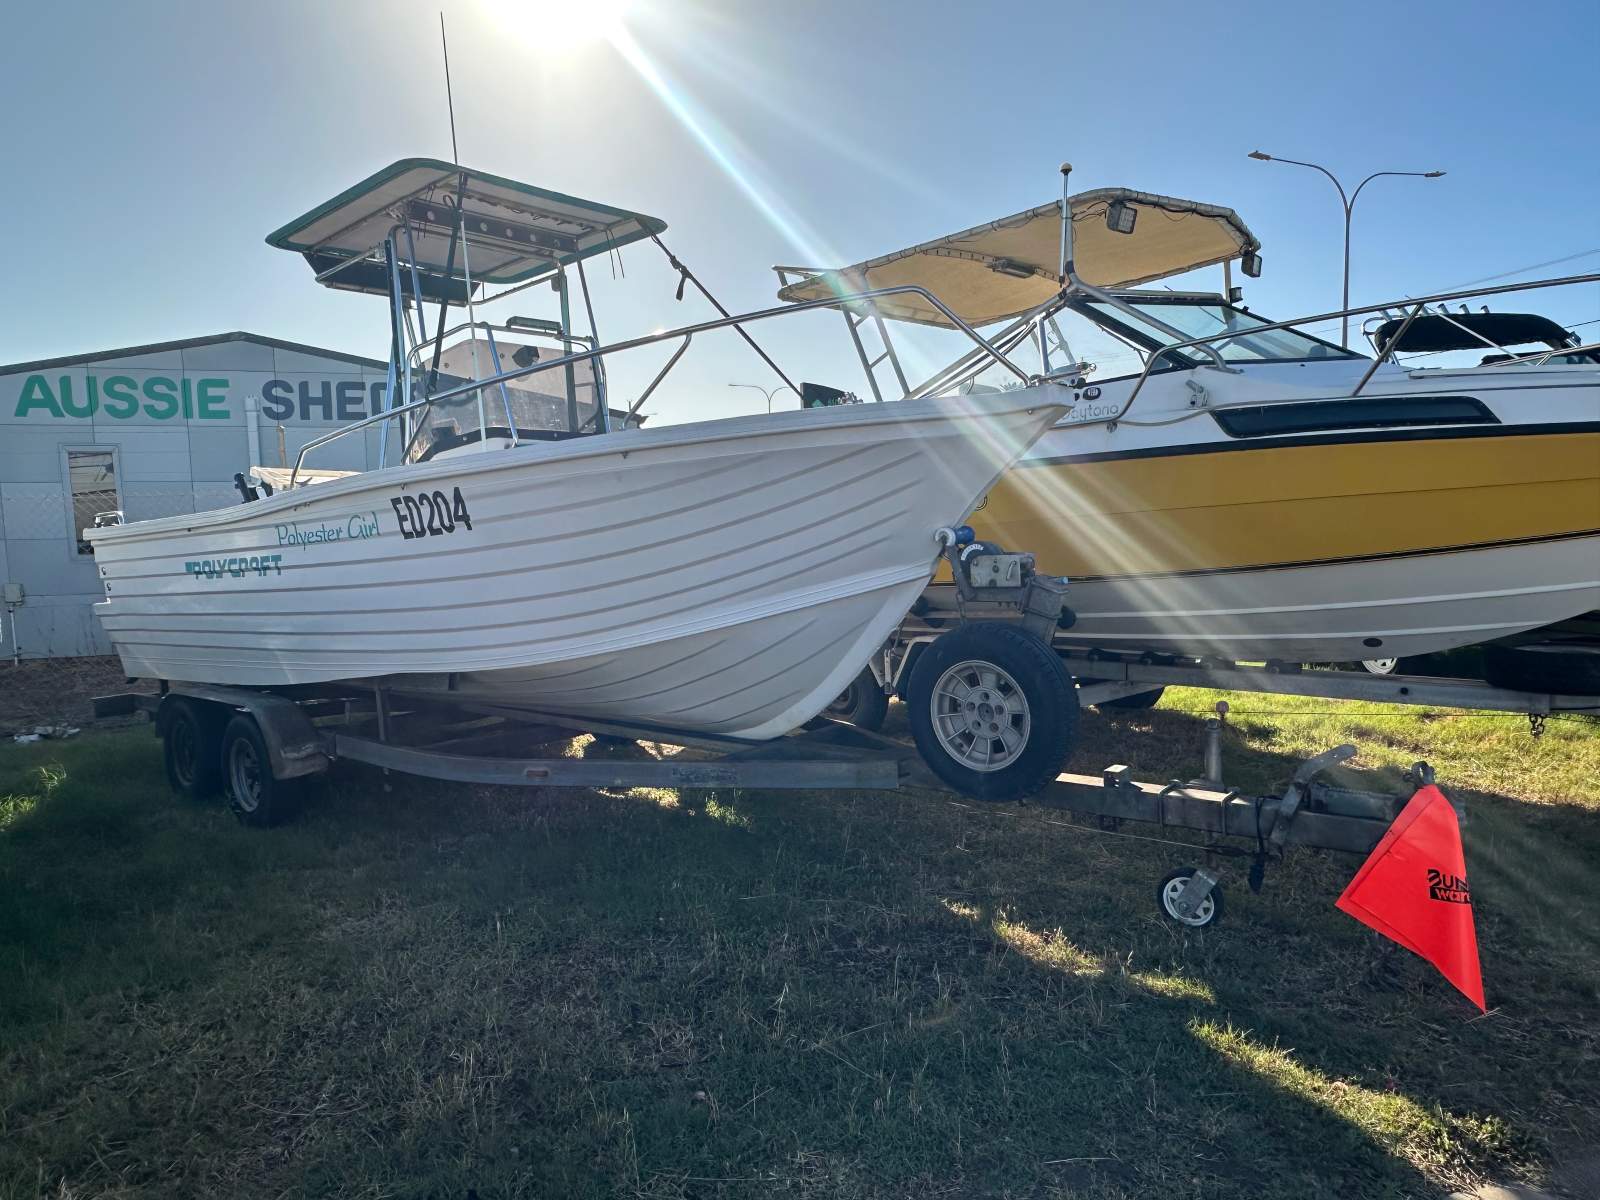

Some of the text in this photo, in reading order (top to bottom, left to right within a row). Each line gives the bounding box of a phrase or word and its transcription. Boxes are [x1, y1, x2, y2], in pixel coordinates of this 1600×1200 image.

[14, 375, 231, 419] AUSSIE
[274, 511, 382, 551] Polyester Girl
[390, 487, 472, 540] ED204
[185, 555, 281, 580] POLYCRAFT
